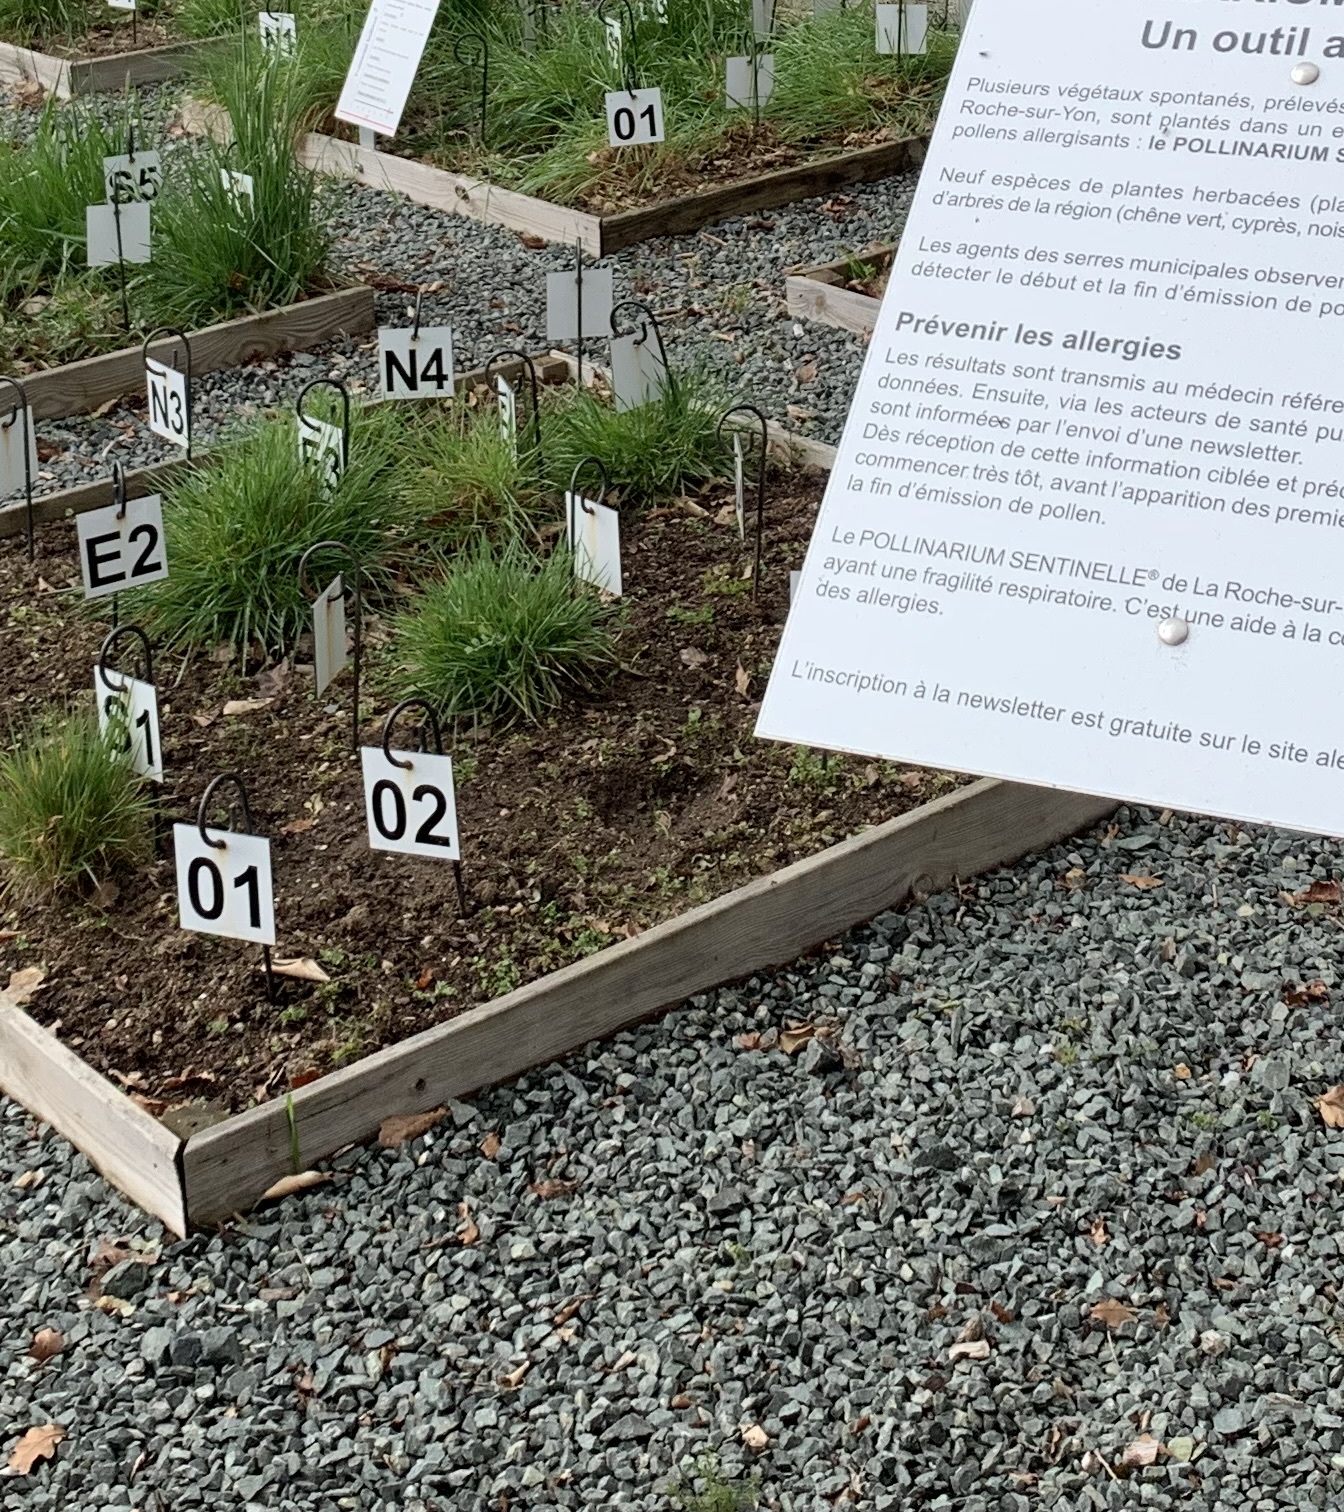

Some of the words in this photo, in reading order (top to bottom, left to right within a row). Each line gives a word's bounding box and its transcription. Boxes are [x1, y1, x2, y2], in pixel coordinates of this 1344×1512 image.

[1141, 19, 1198, 51] Un
[1212, 26, 1311, 57] outil
[966, 77, 1051, 96] Plusieurs
[1057, 83, 1144, 102] végétaux
[1149, 91, 1255, 111] spontanés,
[613, 104, 658, 141] 01
[109, 166, 159, 204] S5
[918, 235, 953, 254] Les
[955, 243, 1020, 260] agents
[1024, 245, 1060, 264] des
[1062, 252, 1125, 270] serres
[1128, 258, 1249, 281] municipales
[894, 311, 1009, 342] Prévenir
[1014, 322, 1054, 347] les
[1061, 329, 1182, 362] allergies
[385, 348, 448, 392] N4
[884, 347, 919, 367] Les
[924, 352, 1006, 376] résultats
[1011, 365, 1056, 382] sont
[1060, 367, 1146, 392] transmis
[1151, 380, 1179, 396] au
[1184, 382, 1274, 406] médecin
[152, 379, 184, 436] N3
[85, 523, 162, 589] E2
[831, 526, 855, 545] Le
[858, 529, 1006, 567] POLLINARIUM
[1161, 573, 1188, 593] de
[1192, 576, 1219, 598] La
[815, 577, 851, 601] des
[856, 586, 943, 615] allergies.
[371, 779, 451, 848] 02
[188, 857, 261, 929] 01
